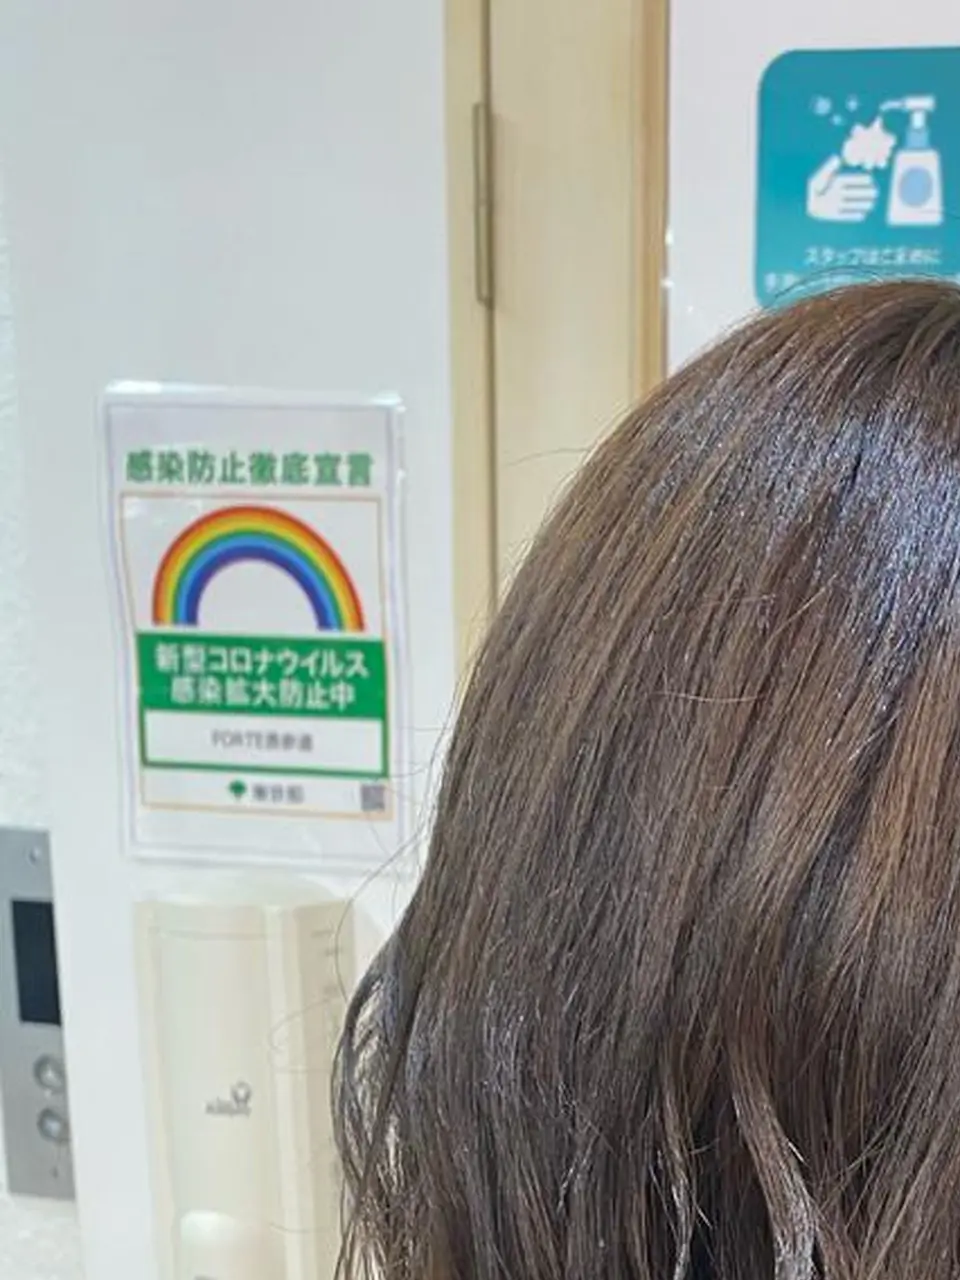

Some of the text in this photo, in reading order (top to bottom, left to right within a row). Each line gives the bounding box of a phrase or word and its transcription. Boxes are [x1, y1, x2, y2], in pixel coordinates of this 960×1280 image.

[126, 449, 374, 487] 感染防止徹底宣言
[155, 643, 369, 679] 新型コロナウイルス
[171, 674, 356, 712] 感染拡大防止中
